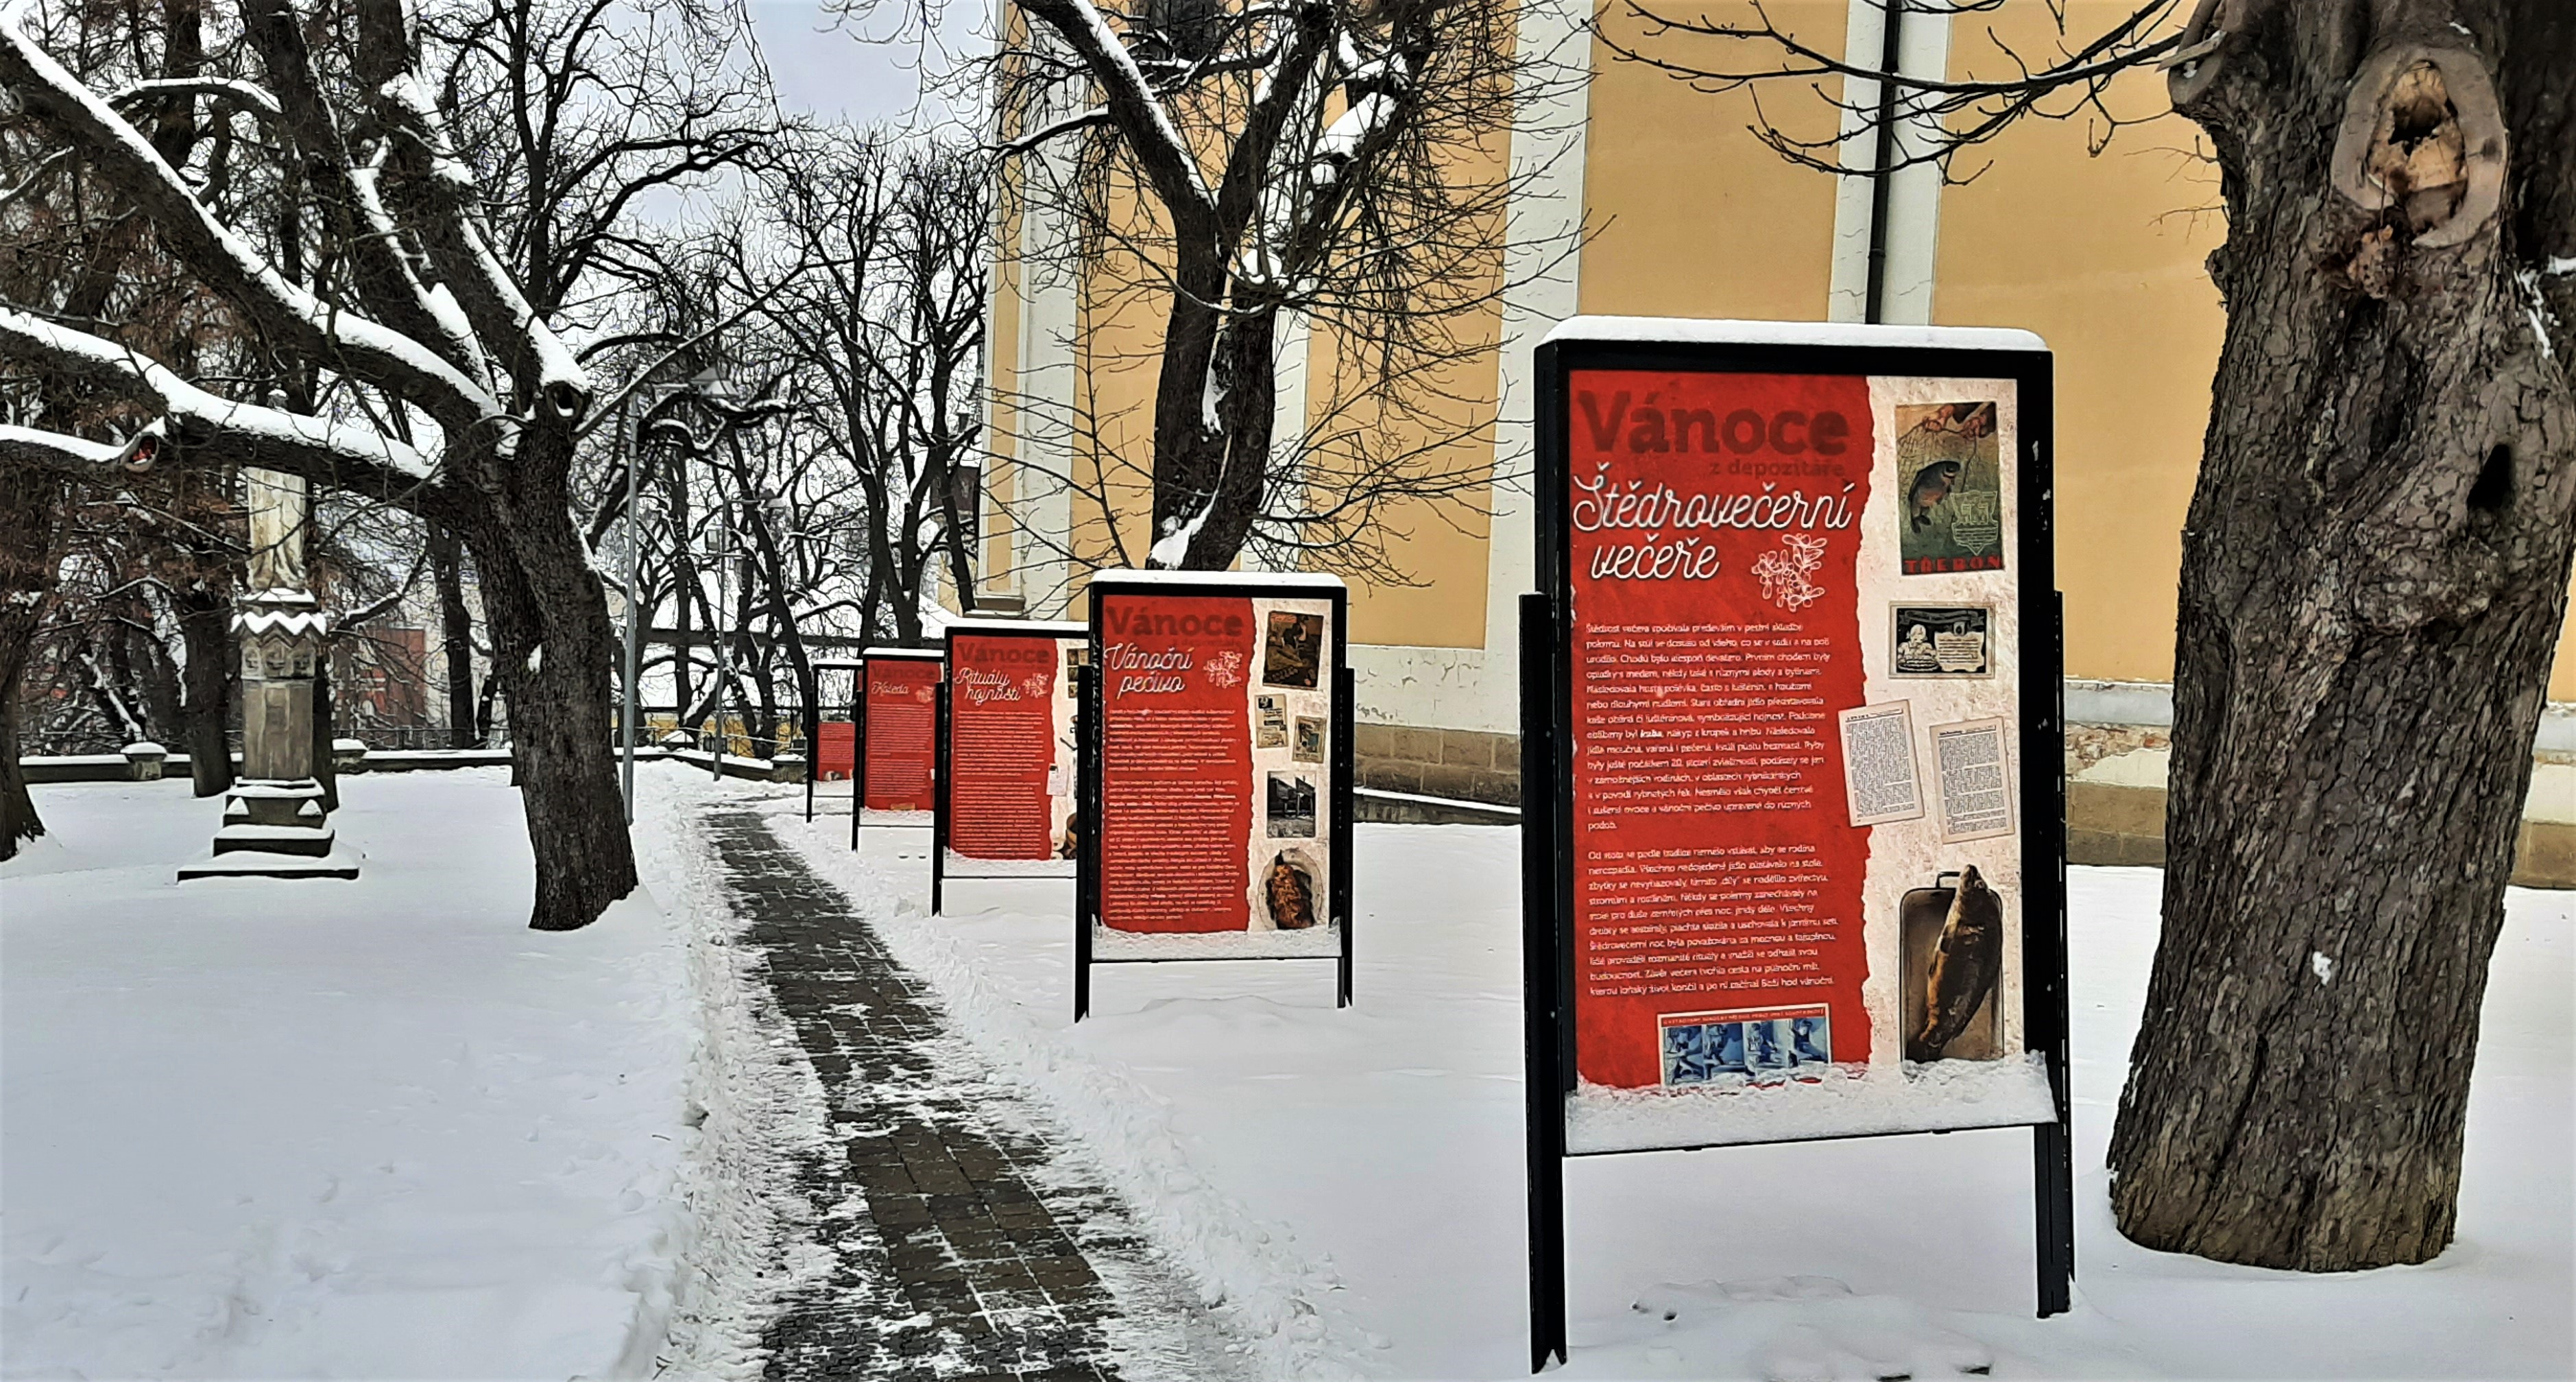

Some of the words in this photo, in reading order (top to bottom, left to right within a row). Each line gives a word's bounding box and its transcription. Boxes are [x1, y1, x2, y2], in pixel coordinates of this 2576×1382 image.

[1578, 390, 1849, 454] Vánoce
[1572, 462, 1853, 531] Štědrovečerní
[1590, 534, 1719, 580] večeře
[1106, 606, 1244, 636] Vánoce
[956, 642, 1049, 663] Vánoce
[1104, 643, 1195, 670] Vánoční
[954, 667, 1011, 688] Rituály
[1116, 670, 1185, 700] pečivo
[965, 685, 1021, 706] hojnosti
